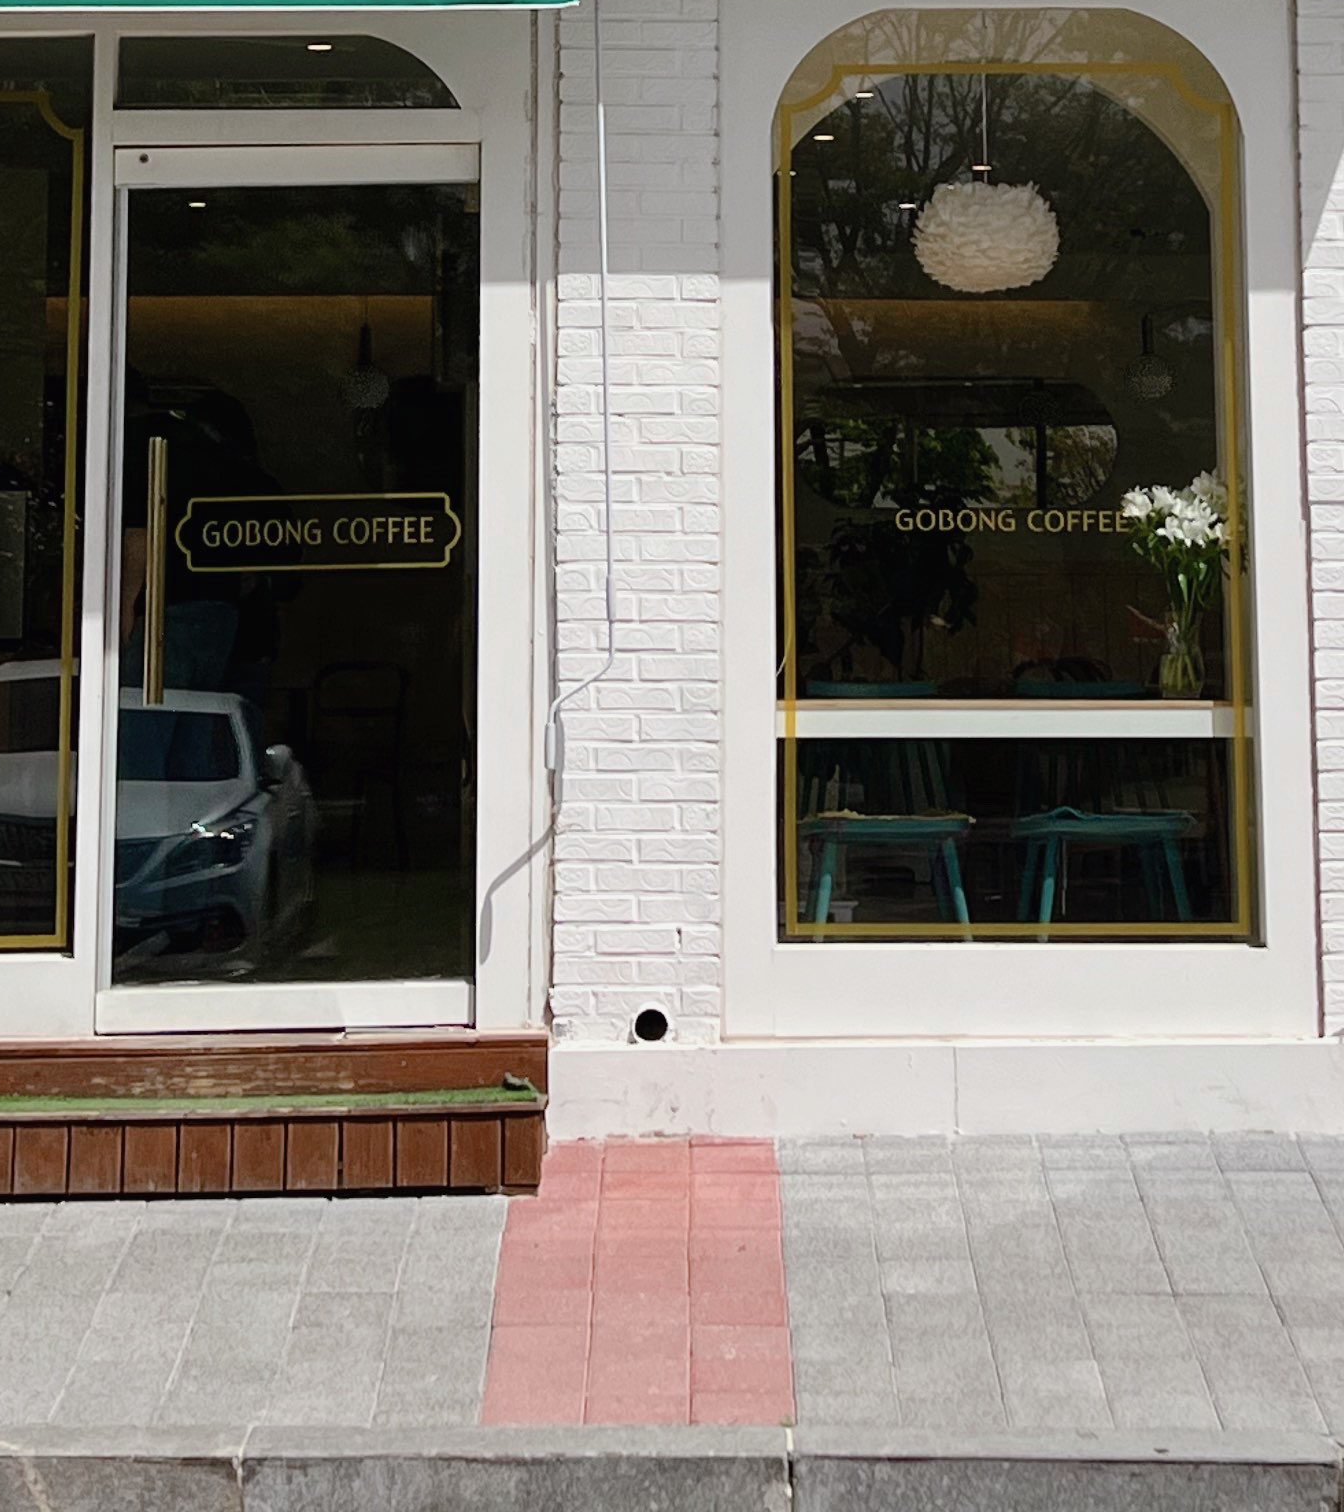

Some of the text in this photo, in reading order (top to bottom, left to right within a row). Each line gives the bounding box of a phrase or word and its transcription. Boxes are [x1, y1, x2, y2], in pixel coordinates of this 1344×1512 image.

[202, 516, 435, 547] GOBONG COFFEE
[895, 509, 1130, 533] GOBONG COFFEE
